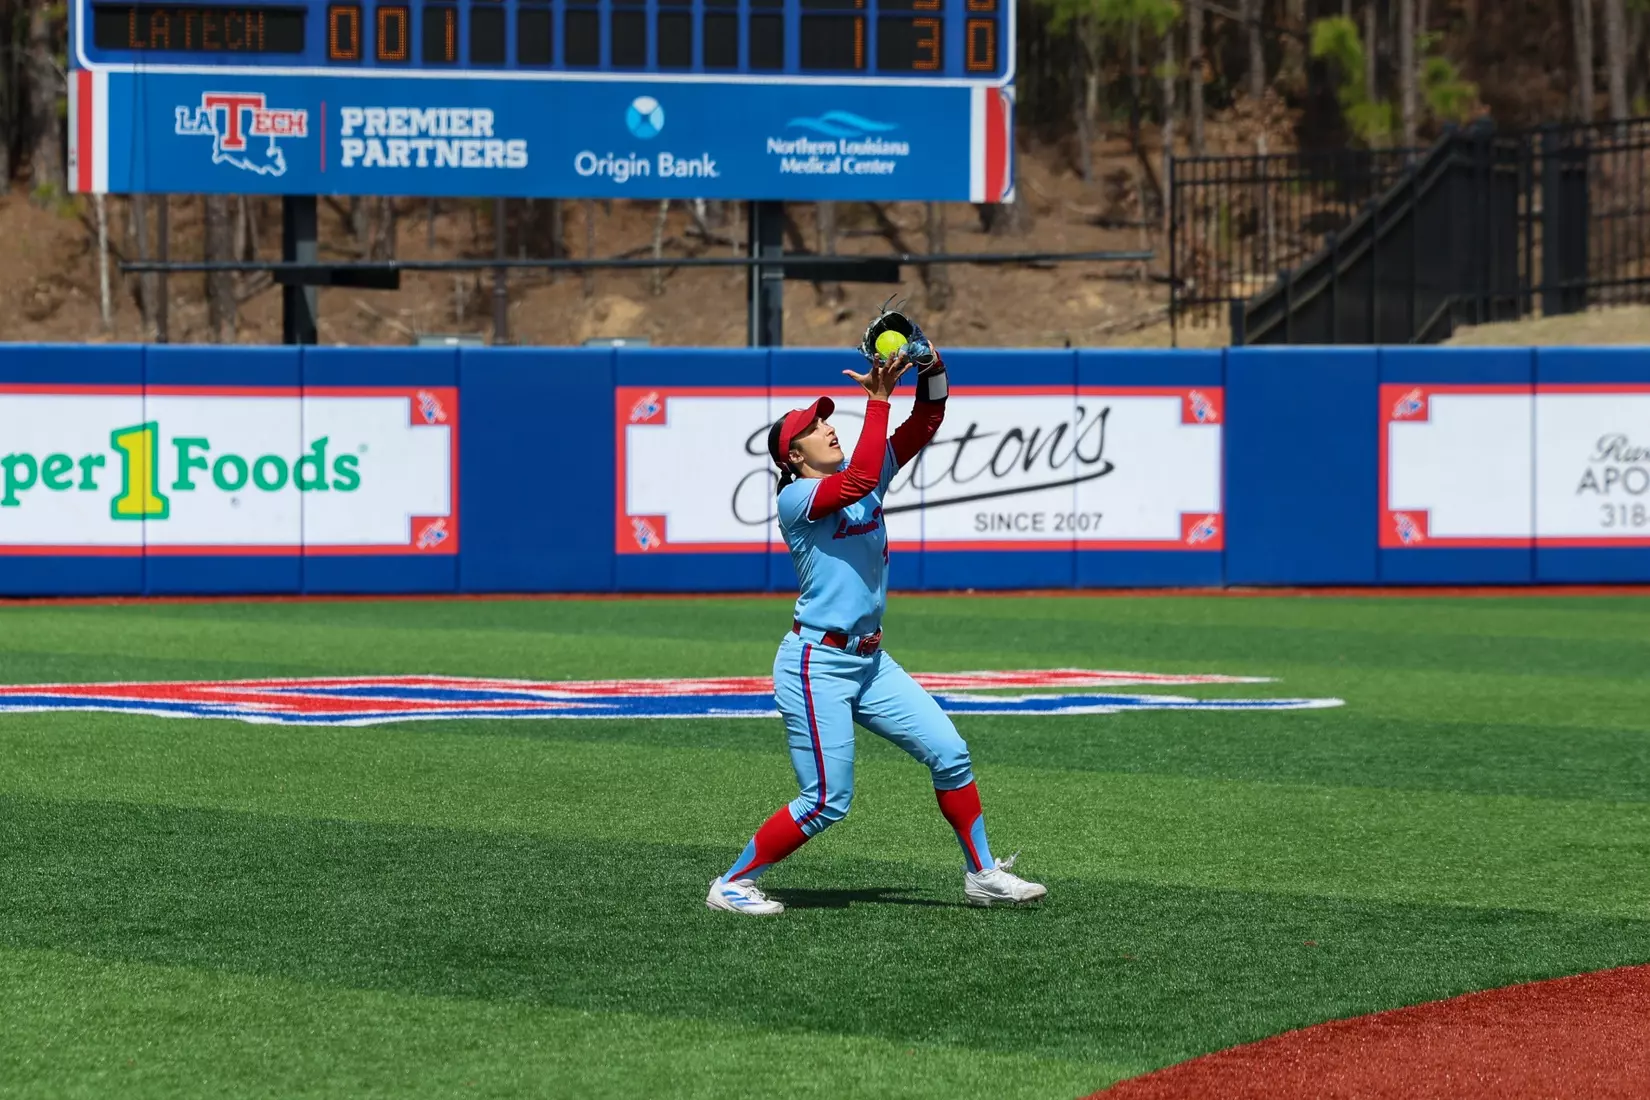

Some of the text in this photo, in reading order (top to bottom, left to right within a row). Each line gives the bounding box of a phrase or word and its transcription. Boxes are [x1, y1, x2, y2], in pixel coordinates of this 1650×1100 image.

[330, 5, 359, 60] 0
[378, 7, 407, 61] 0
[445, 8, 454, 61] 1
[854, 16, 864, 69] 1
[913, 18, 940, 70] 3
[967, 19, 995, 71] 0
[340, 107, 494, 137] PREMIER
[340, 137, 528, 168] PARTNERS
[766, 136, 910, 156] Northern Louisiana
[574, 150, 717, 183] Origin Bank
[780, 156, 896, 175] Medical Center
[1, 421, 361, 520] per 1 Foods
[1575, 465, 1650, 497] APO
[974, 512, 1103, 532] SINCE 2007
